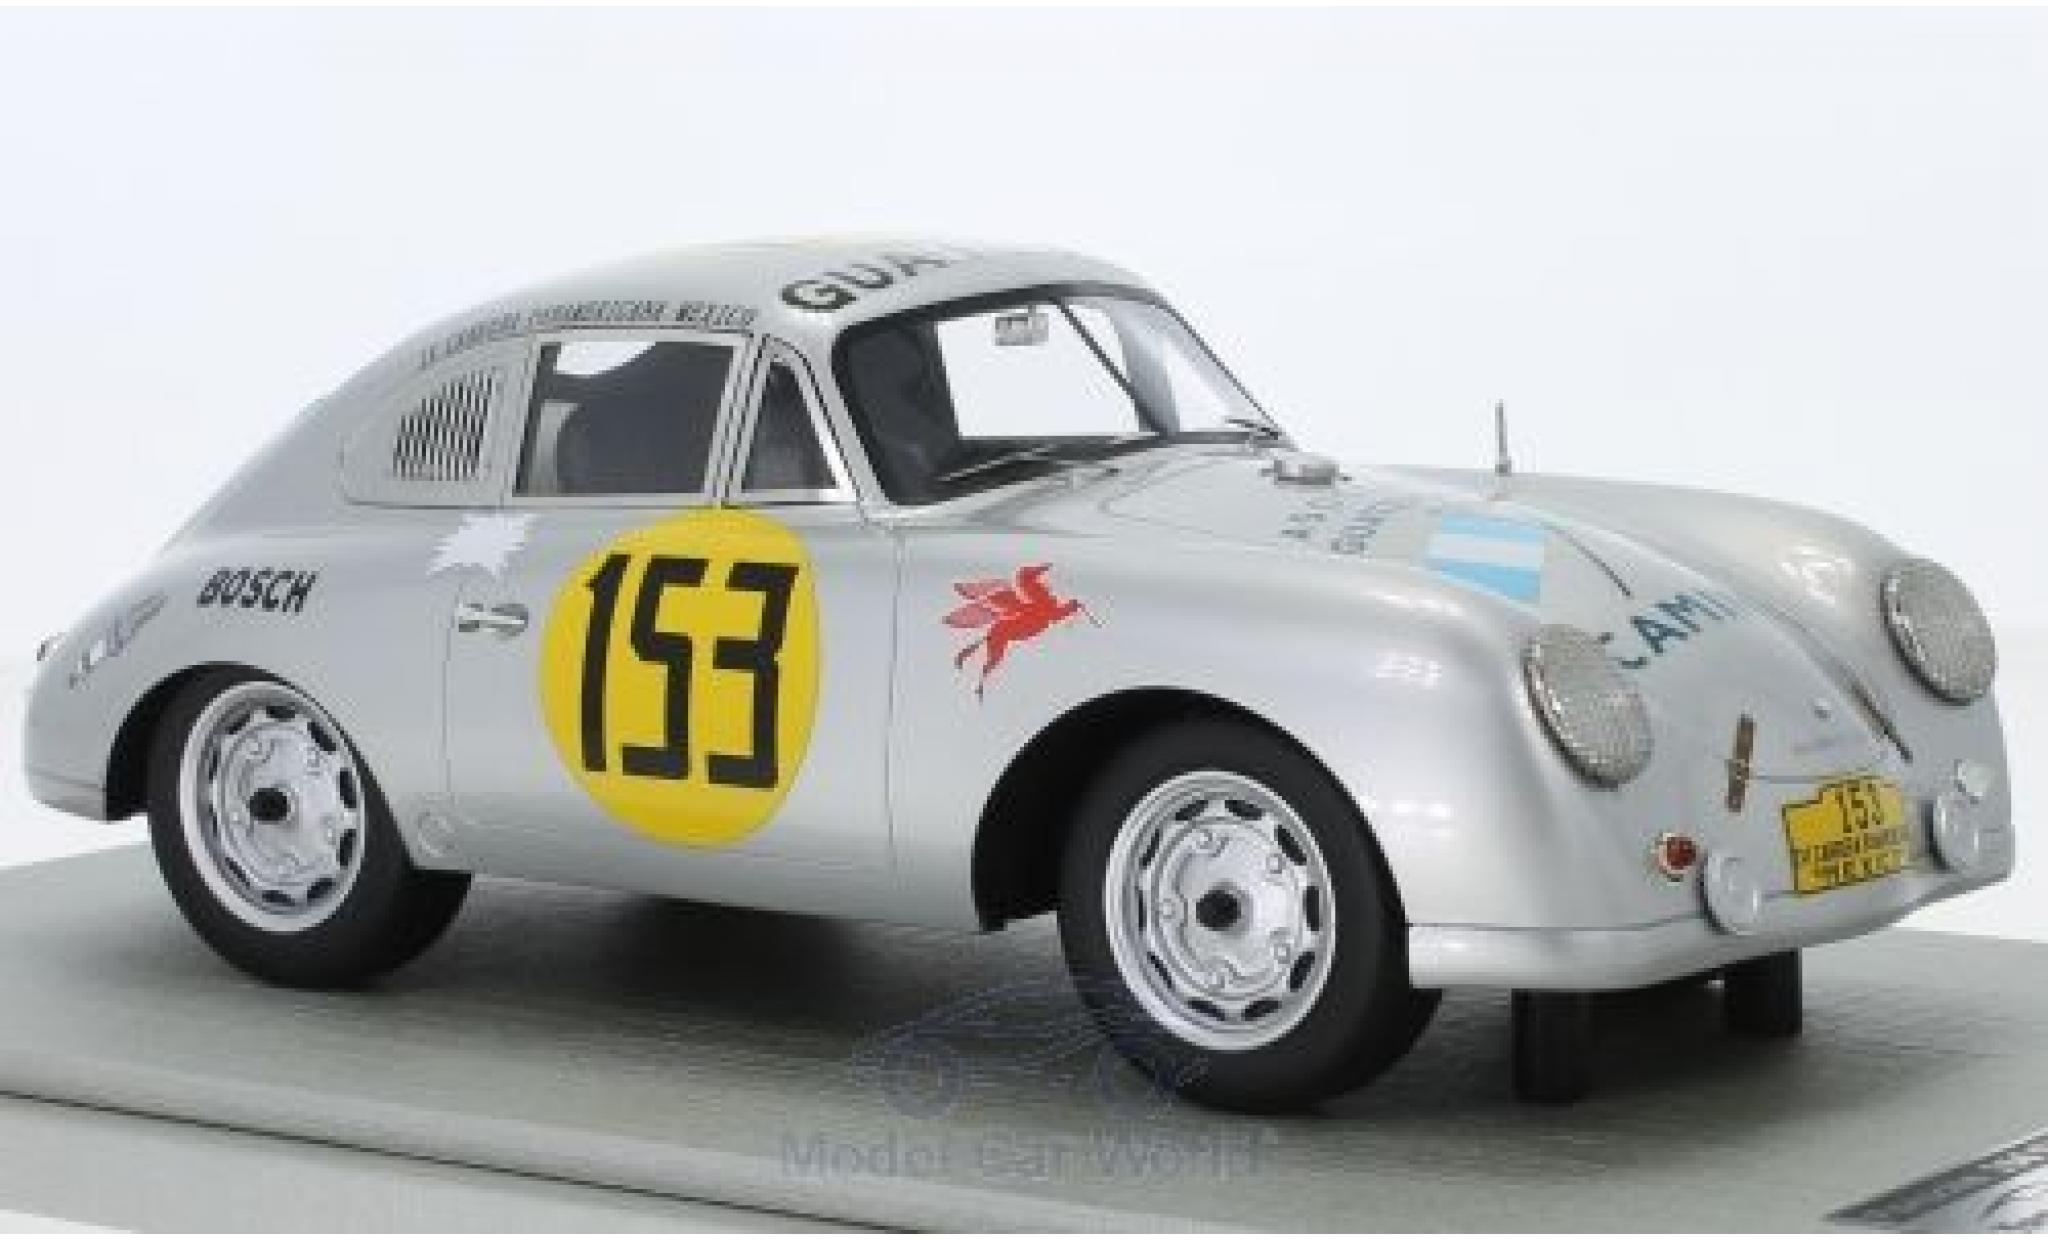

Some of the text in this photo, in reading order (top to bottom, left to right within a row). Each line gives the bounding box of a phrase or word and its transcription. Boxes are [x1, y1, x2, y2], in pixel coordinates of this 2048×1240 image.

[197, 567, 318, 613] BOSCH
[581, 553, 799, 791] 153
[1834, 781, 1886, 834] 153
